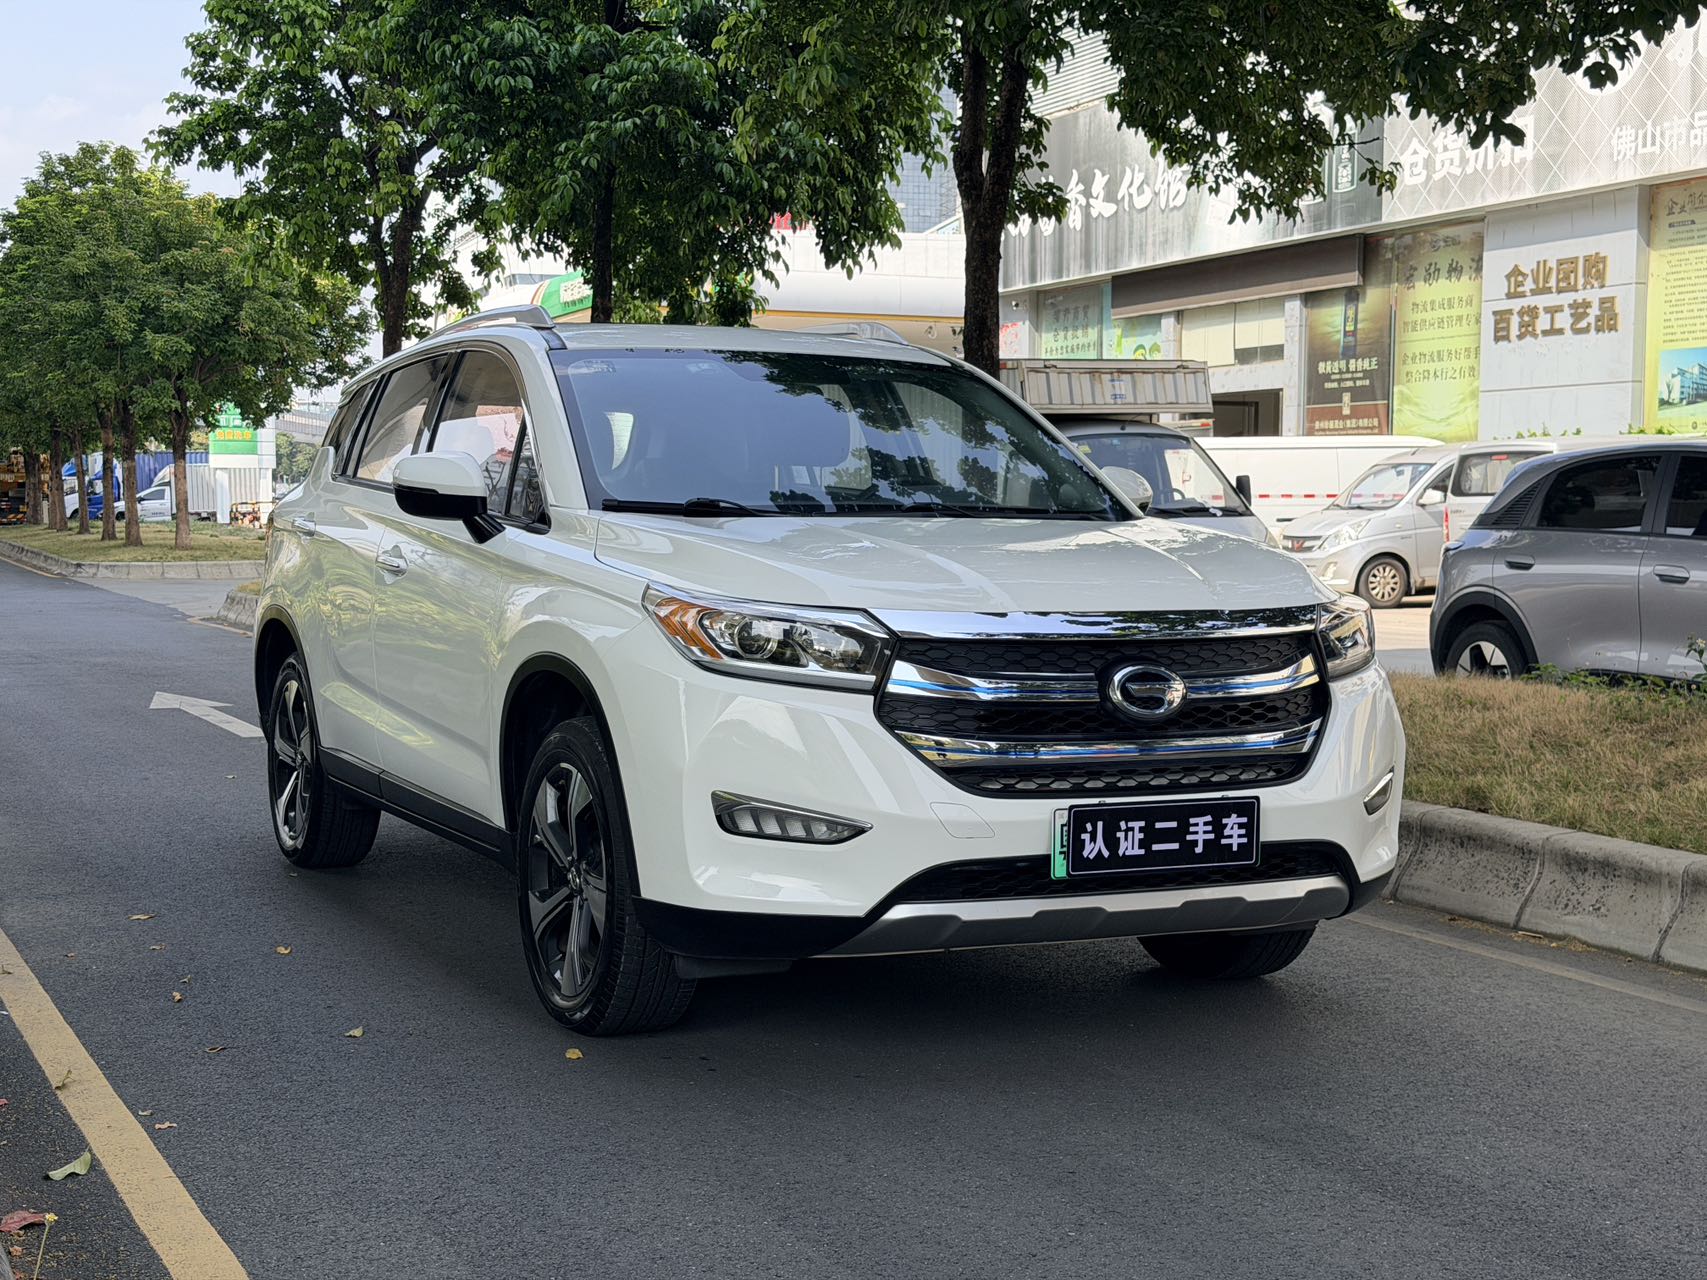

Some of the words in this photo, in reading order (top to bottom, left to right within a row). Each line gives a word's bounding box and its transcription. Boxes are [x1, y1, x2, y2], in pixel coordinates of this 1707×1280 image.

[1504, 252, 1608, 299] 企业团购
[1411, 295, 1474, 315] 物流集成服务商
[1492, 295, 1620, 345] 百货工艺品
[1405, 365, 1477, 384] 整合降本行之有效
[1080, 813, 1249, 860] 认证二手车
